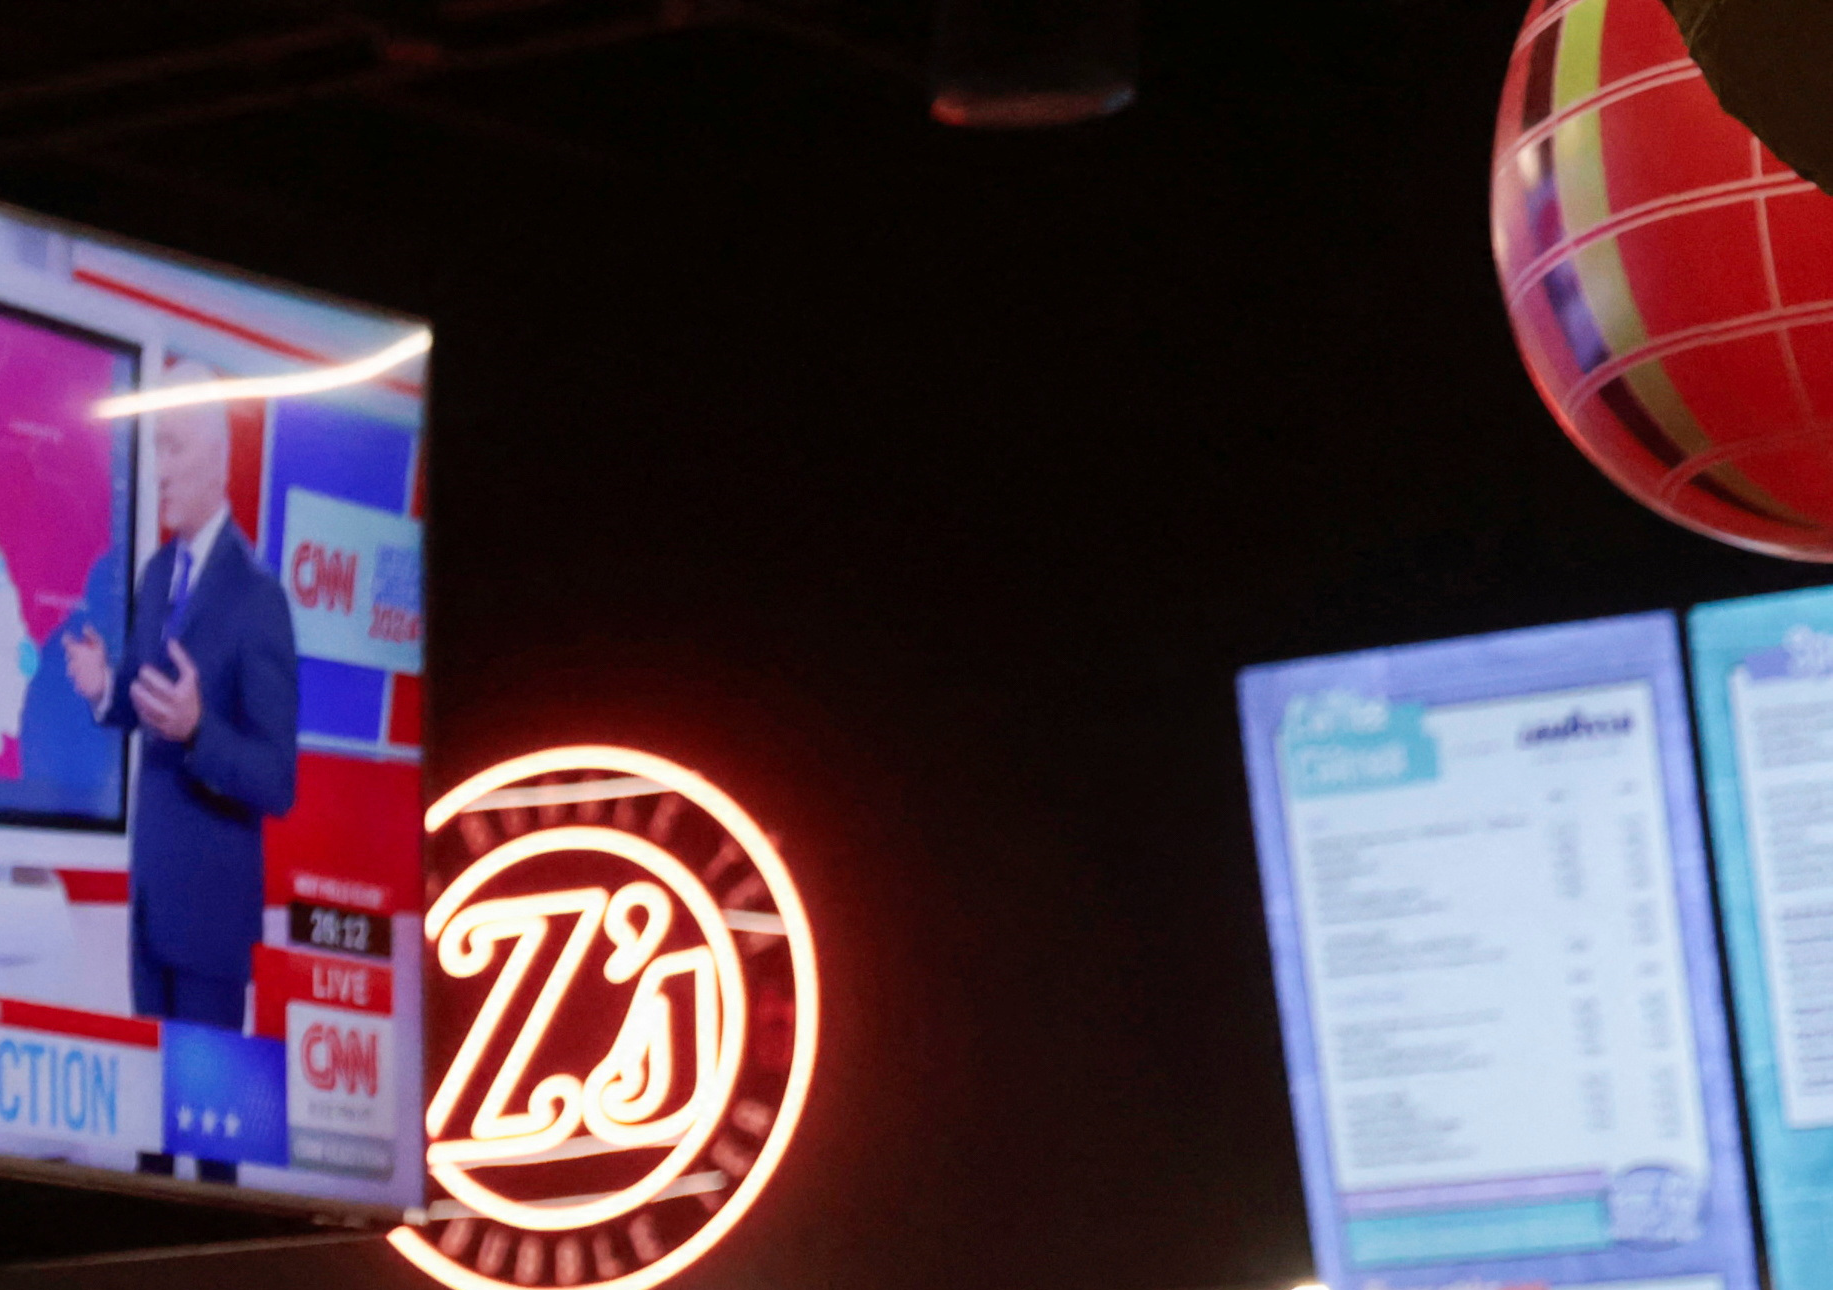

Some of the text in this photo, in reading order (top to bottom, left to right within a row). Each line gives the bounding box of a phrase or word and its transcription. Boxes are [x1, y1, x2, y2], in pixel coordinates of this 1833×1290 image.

[290, 538, 358, 617] CNN
[312, 964, 371, 1007] LIVE
[299, 1019, 379, 1099] CNN
